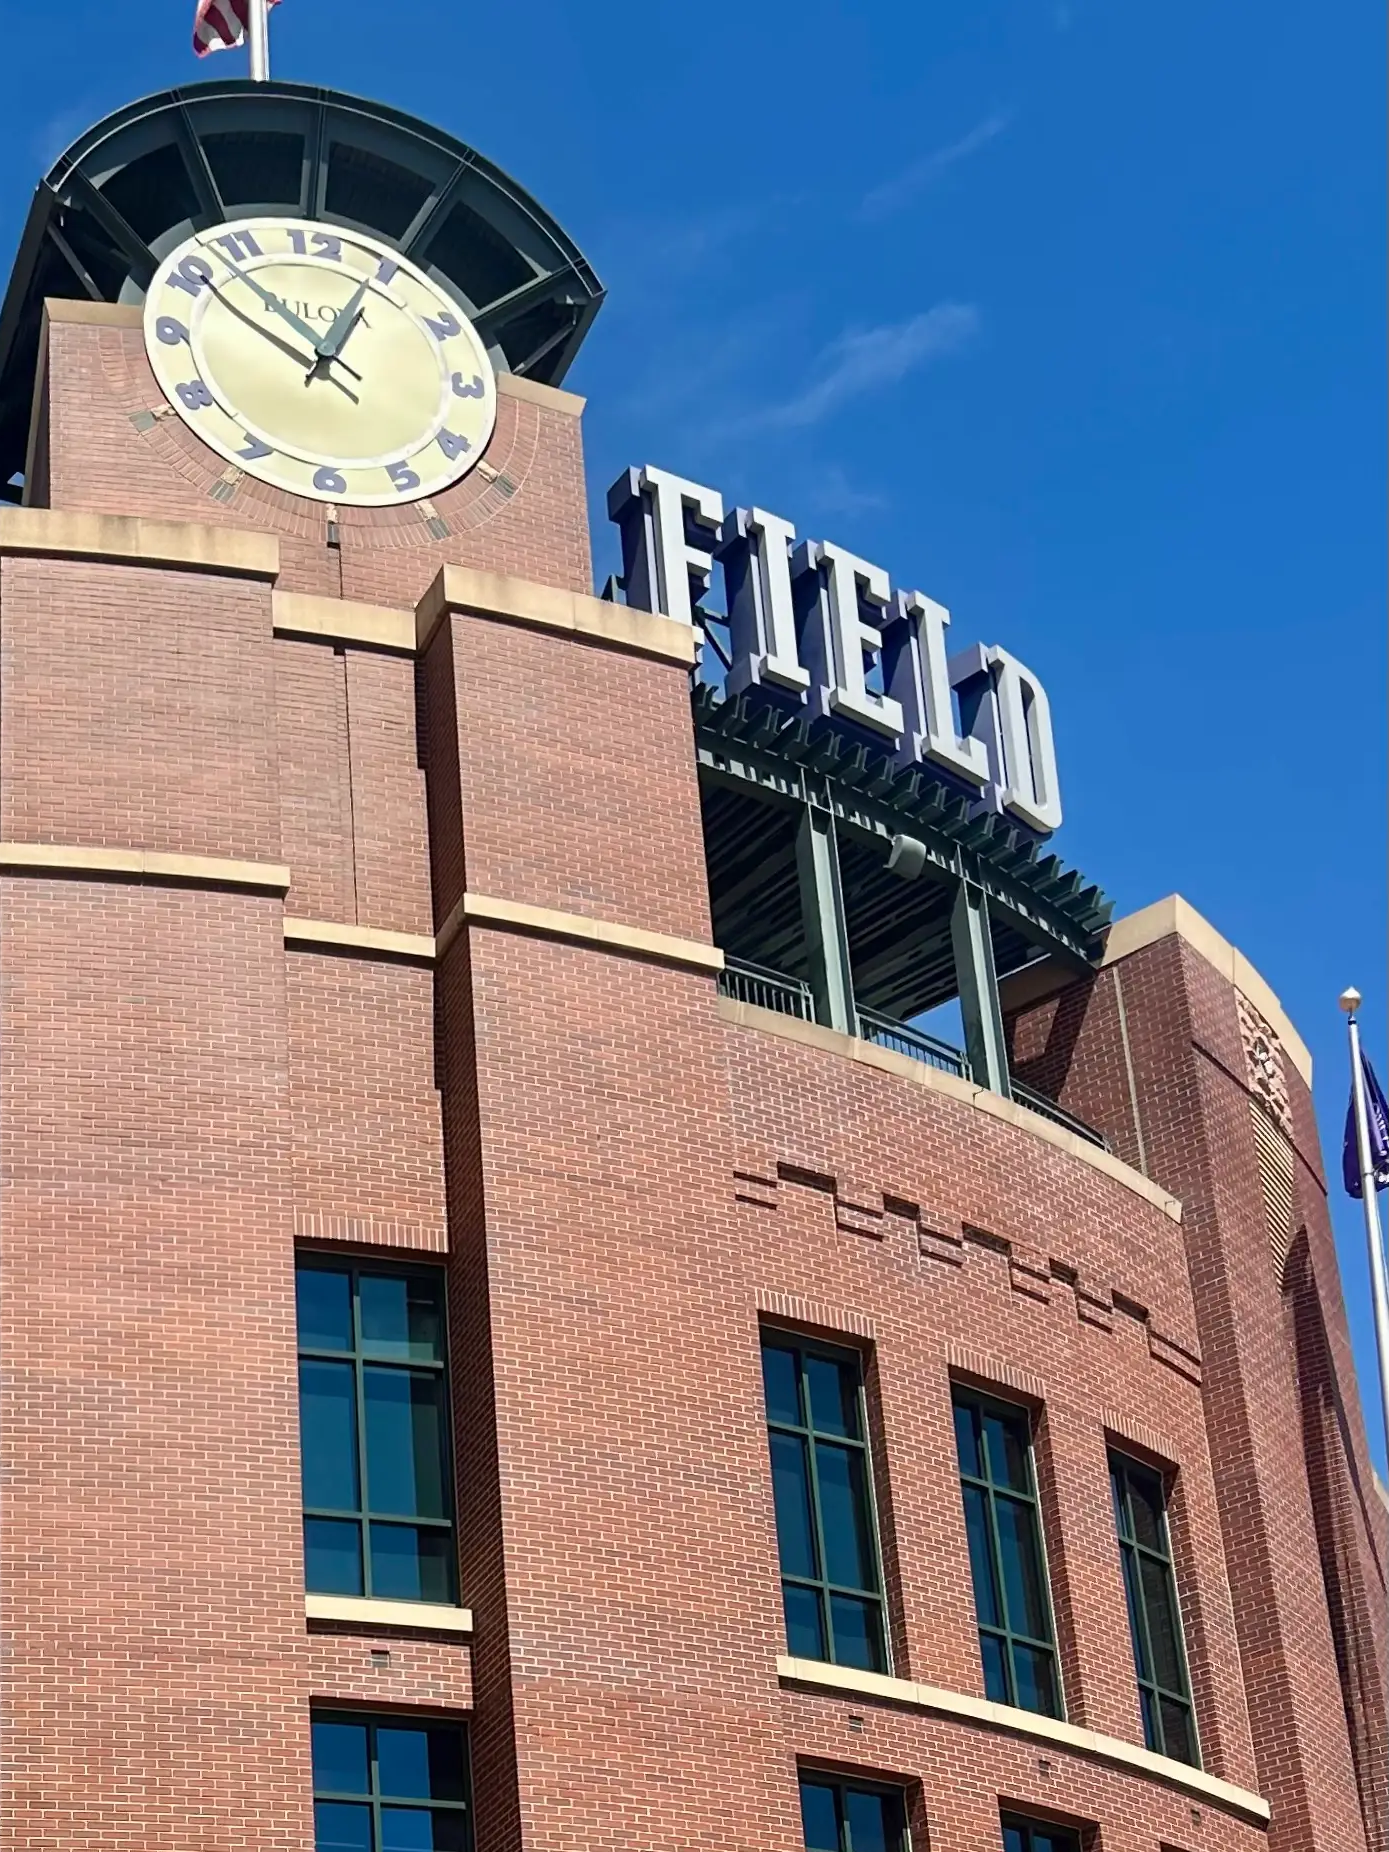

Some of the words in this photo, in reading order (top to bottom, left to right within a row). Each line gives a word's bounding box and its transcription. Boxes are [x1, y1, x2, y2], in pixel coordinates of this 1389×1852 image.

[215, 229, 264, 262] 11
[287, 229, 342, 262] 12
[165, 255, 214, 298] 10
[376, 255, 400, 286] 1
[156, 316, 191, 345] 9
[423, 311, 461, 341] 2
[175, 380, 212, 410] 8
[452, 372, 484, 399] 3
[236, 432, 274, 461] 7
[436, 427, 472, 461] 4
[312, 466, 347, 493] 6
[385, 460, 421, 492] 5
[608, 464, 1063, 840] FIELD
